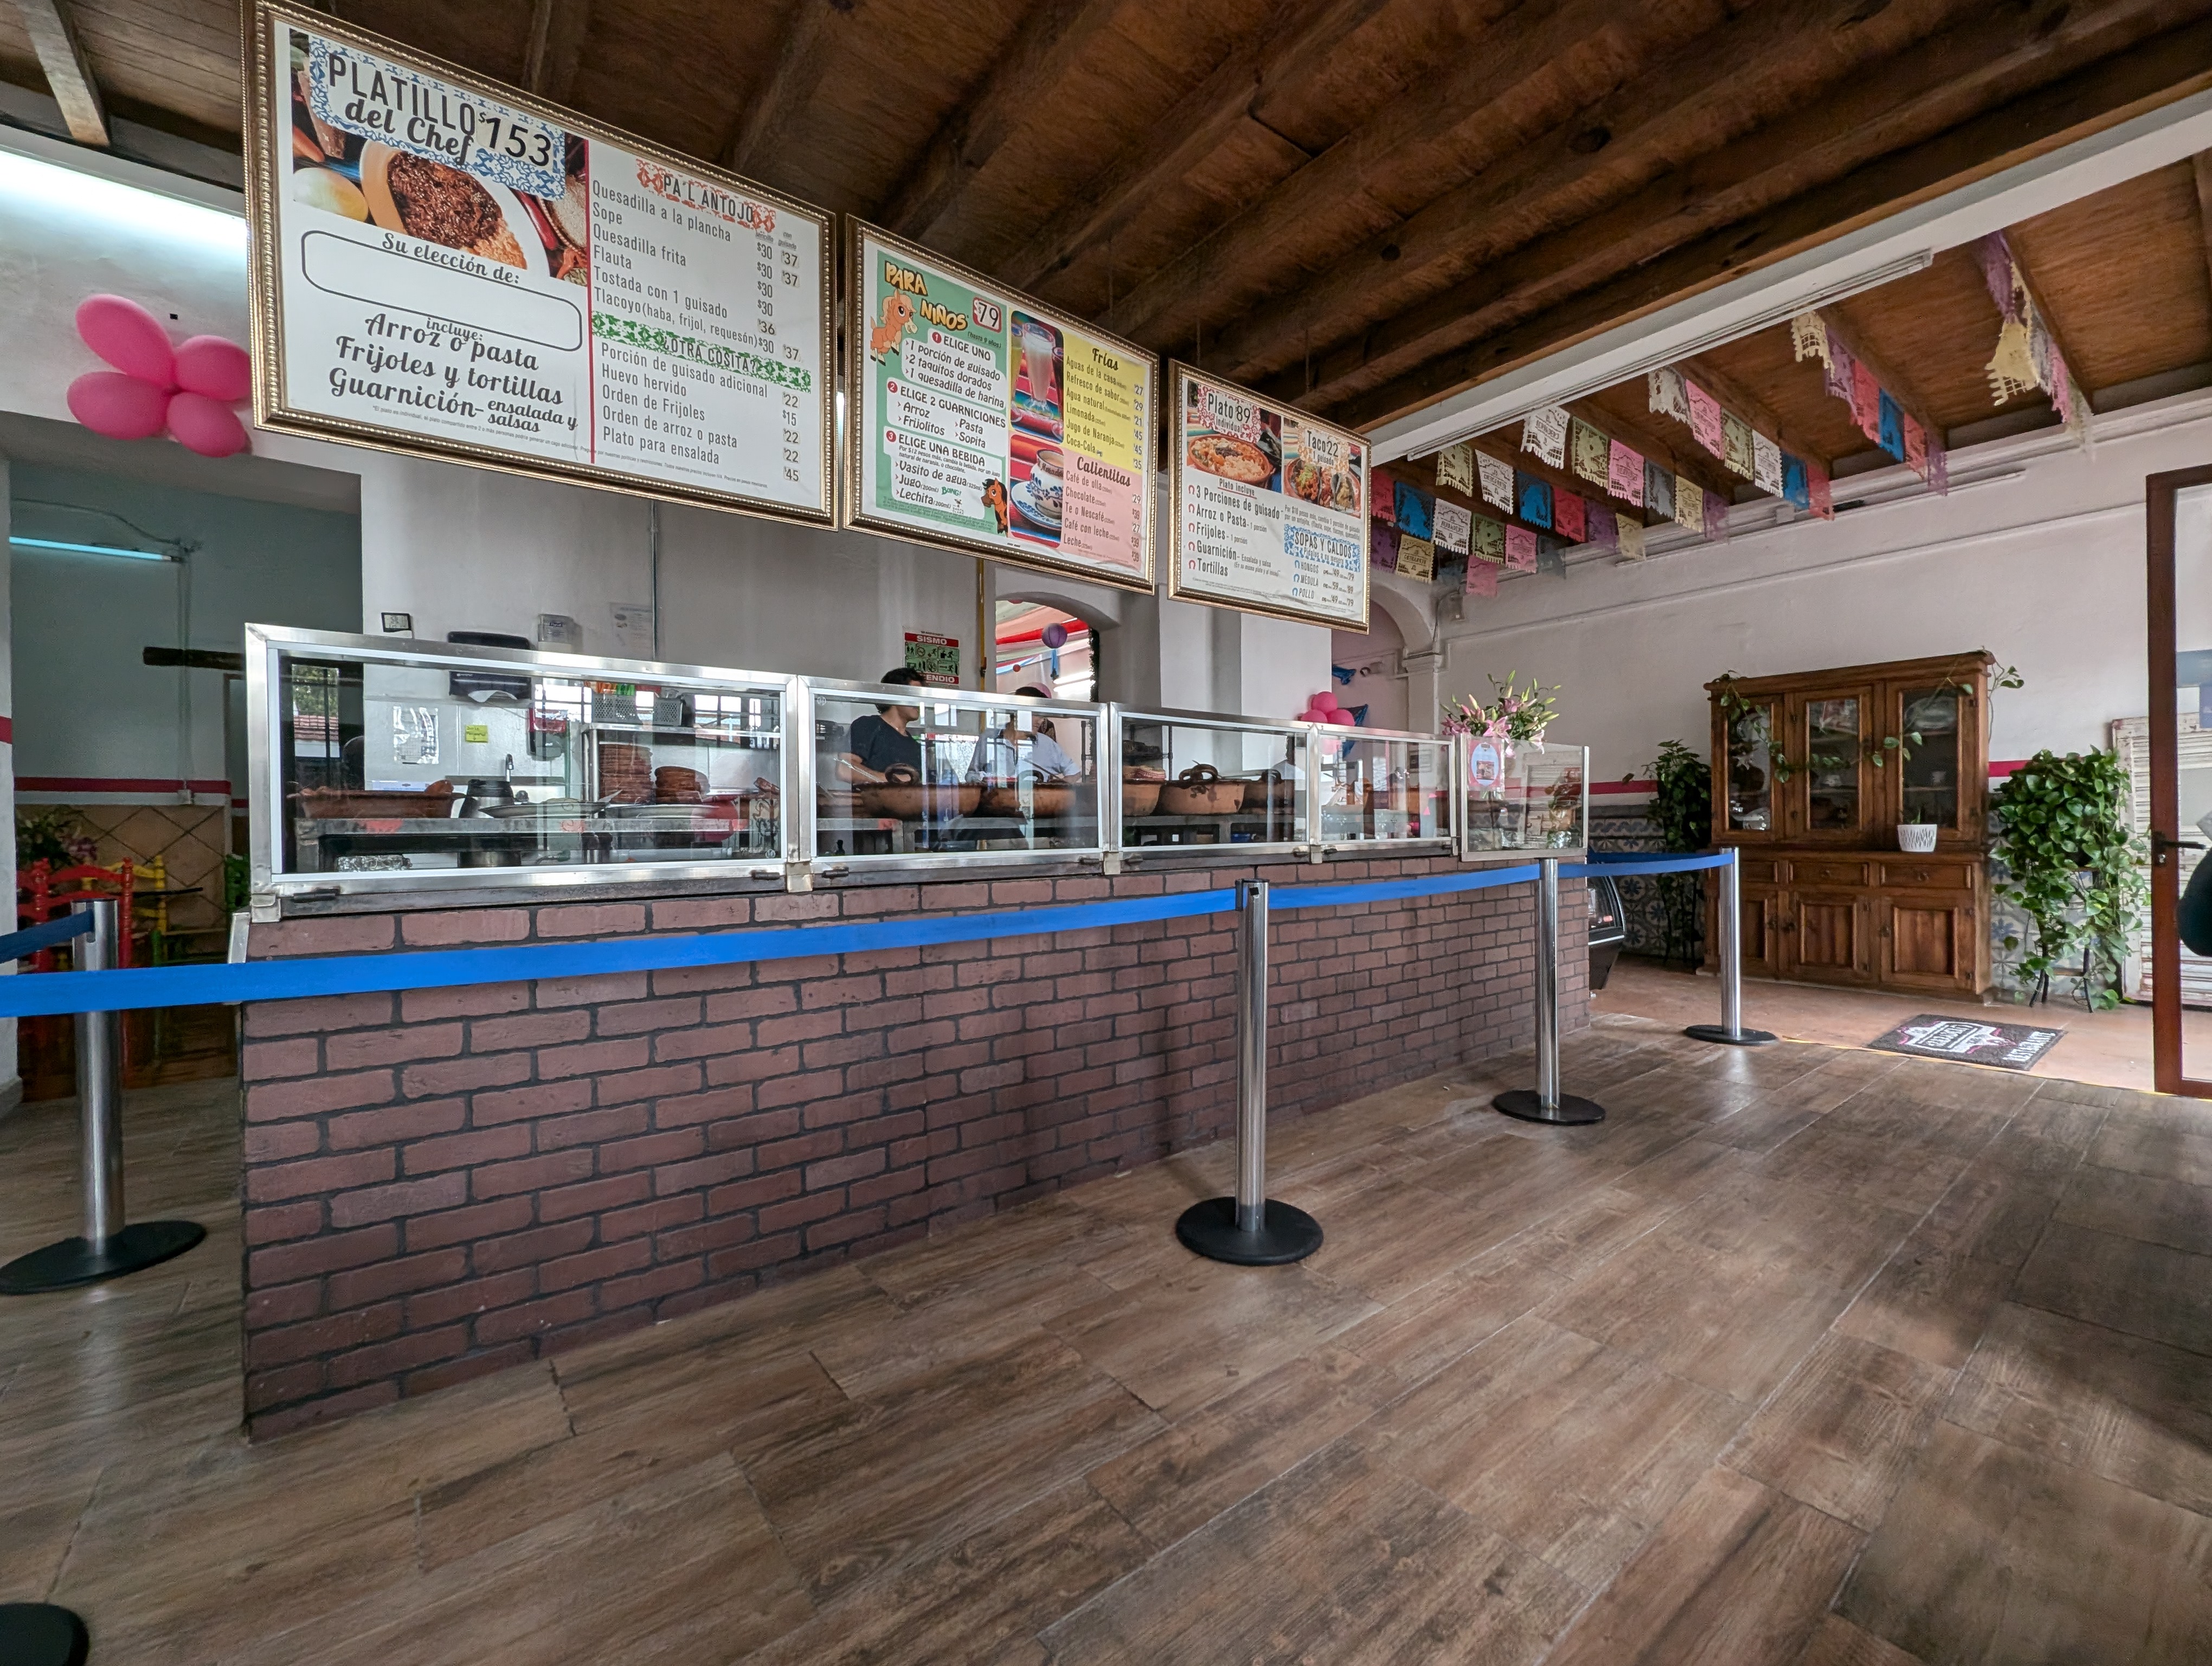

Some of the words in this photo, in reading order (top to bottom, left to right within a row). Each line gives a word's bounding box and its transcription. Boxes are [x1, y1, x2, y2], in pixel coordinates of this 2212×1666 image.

[327, 52, 475, 137] PLATILLO
[478, 112, 551, 166] $153
[345, 99, 395, 133] del
[407, 117, 474, 168] Chef
[593, 180, 655, 215] Quesadilla
[661, 208, 666, 219] a
[673, 208, 682, 225] la
[688, 216, 730, 241] plancha
[757, 242, 772, 259] $30
[702, 190, 753, 222] ANTOJO
[593, 202, 622, 225] Sope
[757, 261, 772, 279] $30
[382, 233, 408, 253] Su
[414, 245, 486, 275] elección
[493, 266, 519, 284] de:
[593, 223, 655, 257] Quesadilla
[661, 246, 685, 266] frita
[757, 281, 772, 298] $30
[594, 244, 631, 270] Flauta
[757, 299, 773, 316] $30
[594, 265, 641, 293] Tostada
[647, 285, 667, 300] con
[673, 290, 677, 304] 1
[685, 297, 726, 318] guisado
[885, 261, 928, 296] PARA
[427, 317, 483, 342] incluye:
[920, 299, 968, 330] NIÑOS
[365, 313, 440, 347] Arroz
[449, 335, 465, 352] o
[470, 336, 538, 370] pasta
[679, 312, 705, 334] frijol,
[710, 325, 757, 348] requesón)
[758, 337, 774, 354] $30
[943, 335, 969, 354] ELIGE
[972, 345, 990, 361] UNO
[336, 336, 436, 376] Frijoles
[445, 366, 460, 388] y
[468, 368, 563, 405] tortillas
[602, 342, 647, 367] Porción
[653, 356, 666, 371] de
[672, 364, 714, 384] guisado
[720, 375, 767, 398] adicional
[664, 336, 702, 359] ¿OTRA
[708, 348, 756, 376] COSITA?
[909, 354, 915, 364] 2
[918, 357, 954, 378] taquitos
[957, 371, 992, 390] dorados
[911, 340, 914, 350] 1
[918, 344, 951, 364] porción
[954, 357, 964, 368] de
[967, 363, 1000, 381] guisado
[1066, 355, 1084, 371] Aguas
[1086, 364, 1094, 375] de
[1096, 367, 1101, 379] la
[1092, 348, 1118, 370] Frías
[602, 363, 638, 385] Huevo
[644, 373, 686, 396] hervido
[782, 409, 796, 426] $15
[910, 368, 914, 378] 1
[917, 373, 962, 394] quesadilla
[965, 387, 975, 398] de
[978, 390, 1004, 408] harina
[1066, 370, 1092, 390] Refresco
[1095, 383, 1102, 394] de
[1066, 387, 1081, 401] Agua
[487, 400, 563, 424] ensalada
[567, 414, 578, 432] y
[602, 384, 637, 406] Orden
[644, 394, 657, 409] de
[663, 398, 704, 421] Frijoles
[901, 386, 927, 403] ELIGE
[930, 396, 935, 406] 2
[938, 399, 1005, 428] GUARNICIONES
[903, 402, 930, 418] Arroz
[959, 418, 982, 434] Pasta
[1208, 393, 1233, 419] Plato
[487, 414, 539, 432] salsas
[603, 405, 638, 426] Orden
[644, 415, 657, 430] de
[663, 422, 692, 438] arroz
[697, 430, 703, 440] o
[709, 432, 737, 448] pasta
[903, 415, 944, 435] Frijolitos
[959, 432, 985, 448] Sopita
[1066, 418, 1081, 433] Jugo
[1083, 425, 1090, 436] de
[603, 426, 633, 446] Plato
[640, 438, 665, 452] para
[671, 444, 718, 464] ensalada
[898, 433, 926, 450] ELIGE
[931, 443, 949, 456] UNA
[952, 448, 985, 466] BEBIDA
[1066, 433, 1095, 453] Coca-Cola
[1307, 430, 1325, 452] Taco
[899, 460, 929, 477] Vasito
[931, 469, 943, 480] de
[1066, 470, 1079, 483] Café
[1082, 476, 1089, 486] de
[1077, 456, 1130, 486] Calientitas
[1197, 485, 1200, 498] 3
[1204, 487, 1240, 508] Porciones
[1243, 498, 1251, 511] de
[1219, 478, 1233, 490] Plato
[1236, 483, 1255, 496] incluye
[1065, 501, 1072, 513] Te
[1196, 503, 1216, 520] Arroz
[1220, 512, 1224, 521] o
[1064, 517, 1078, 530] Café
[1080, 524, 1091, 534] con
[1197, 521, 1225, 540] Frijoles
[1295, 531, 1317, 549] SOPAS
[1320, 539, 1324, 550] Y
[1327, 540, 1351, 558] CALDOS
[1197, 558, 1227, 576] Tortillas
[1298, 587, 1314, 599] POLLO
[916, 635, 947, 645] SISMO
